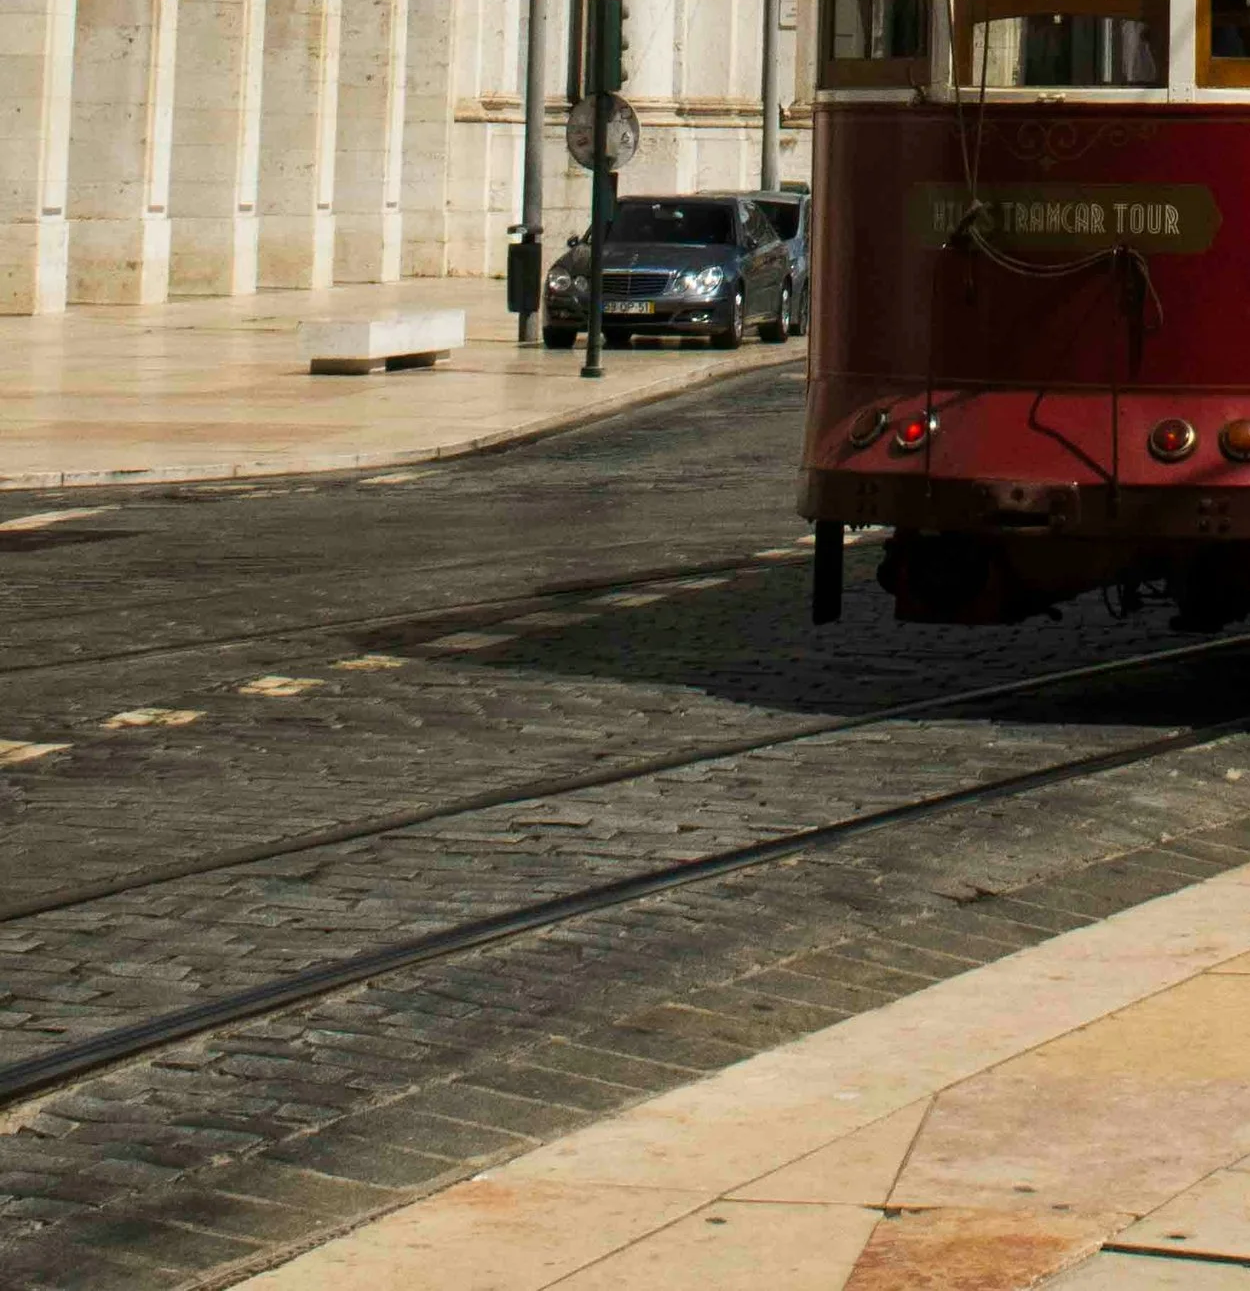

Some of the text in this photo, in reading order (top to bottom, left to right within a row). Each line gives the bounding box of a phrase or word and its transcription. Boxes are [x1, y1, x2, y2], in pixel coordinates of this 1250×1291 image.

[933, 202, 1180, 235] HIS TRAMCAR TOUR
